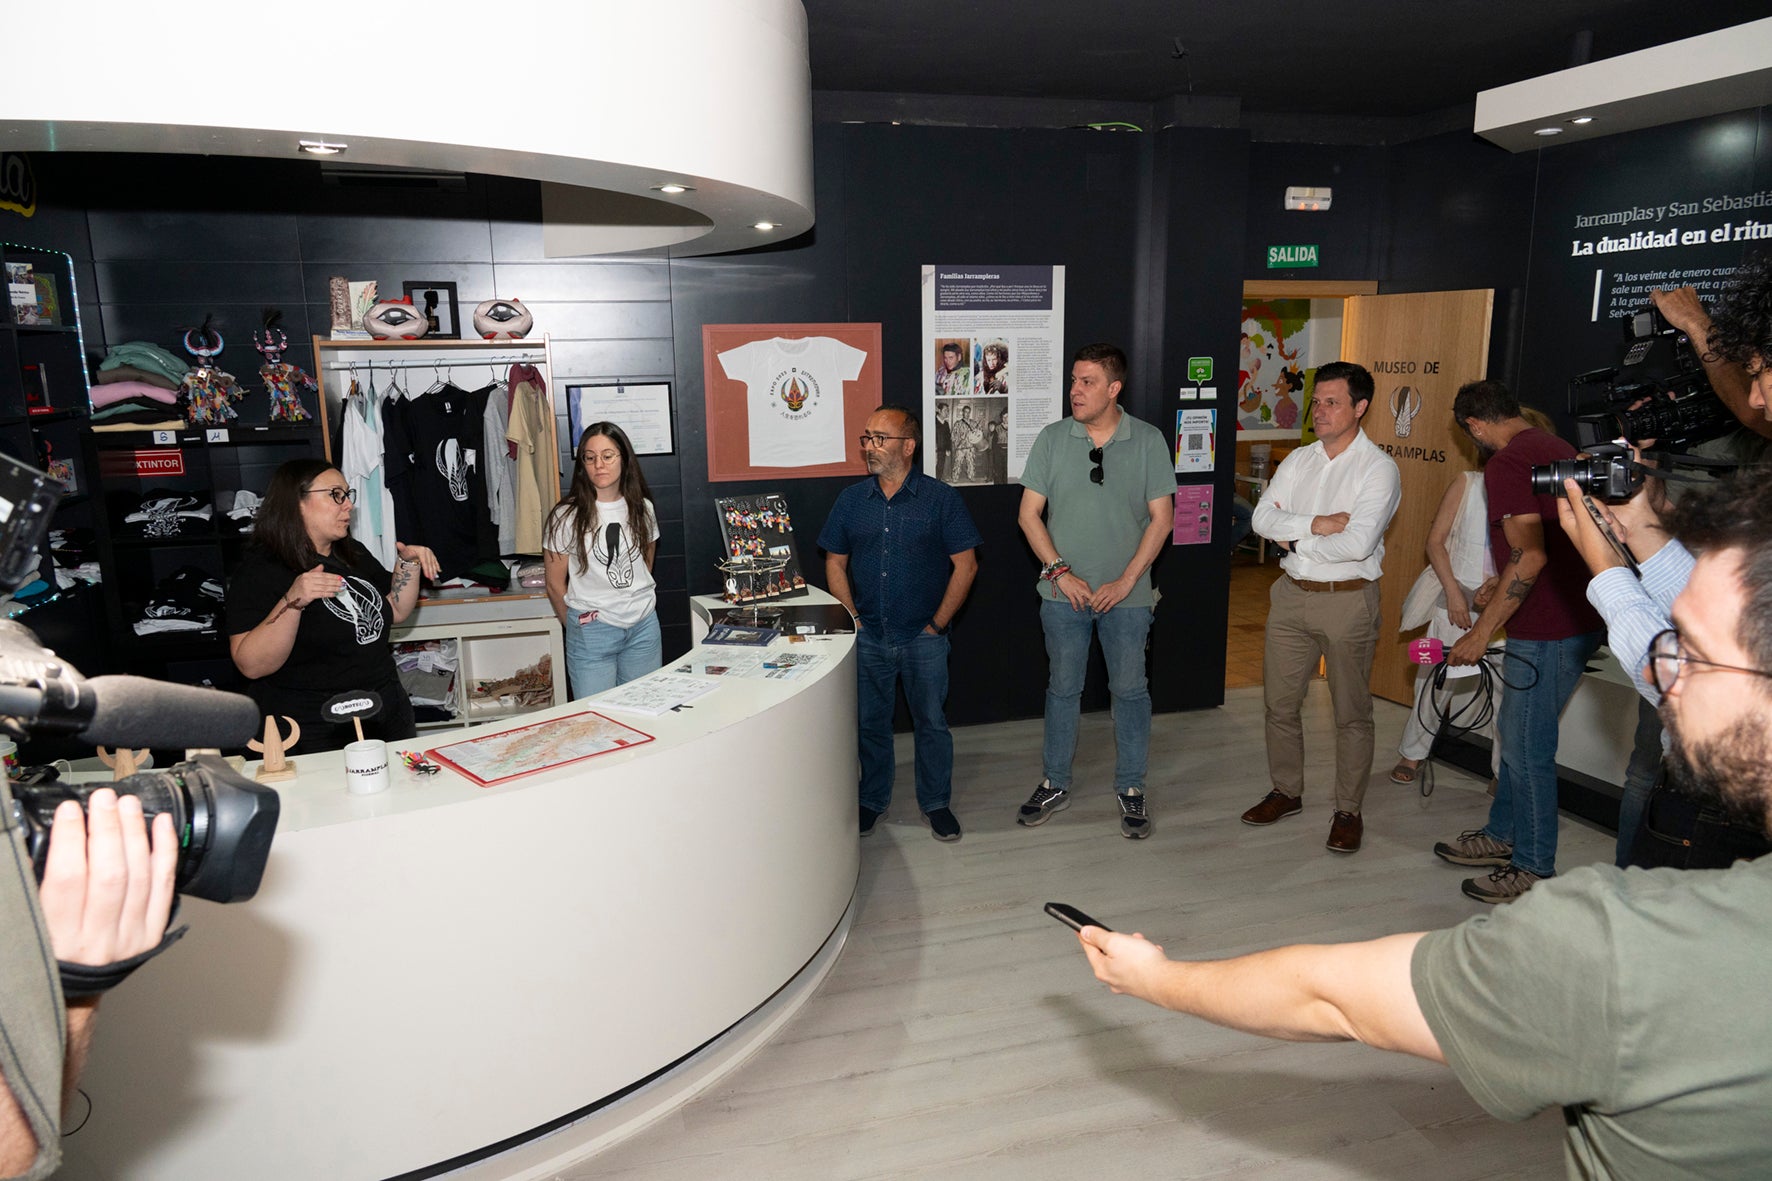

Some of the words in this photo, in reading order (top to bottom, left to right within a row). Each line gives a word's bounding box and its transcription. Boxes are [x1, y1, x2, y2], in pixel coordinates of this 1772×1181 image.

[1574, 206, 1654, 229] Jarramplas
[1655, 206, 1667, 222] y
[1669, 202, 1698, 217] San
[1571, 240, 1594, 257] La
[1596, 228, 1677, 254] dualidad
[1681, 229, 1707, 246] en
[1710, 223, 1732, 243] el
[1269, 246, 1317, 262] SALIDA
[1625, 272, 1638, 282] los
[1639, 269, 1667, 281] veinte
[1668, 268, 1681, 279] de
[1682, 267, 1711, 278] enero
[1611, 284, 1630, 295] sale
[1631, 285, 1643, 293] un
[1712, 280, 1720, 289] a
[1610, 297, 1617, 307] A
[1618, 296, 1628, 306] la
[1374, 361, 1416, 374] MUSEO
[1424, 362, 1440, 374] DE
[135, 459, 179, 469] XTINTOR
